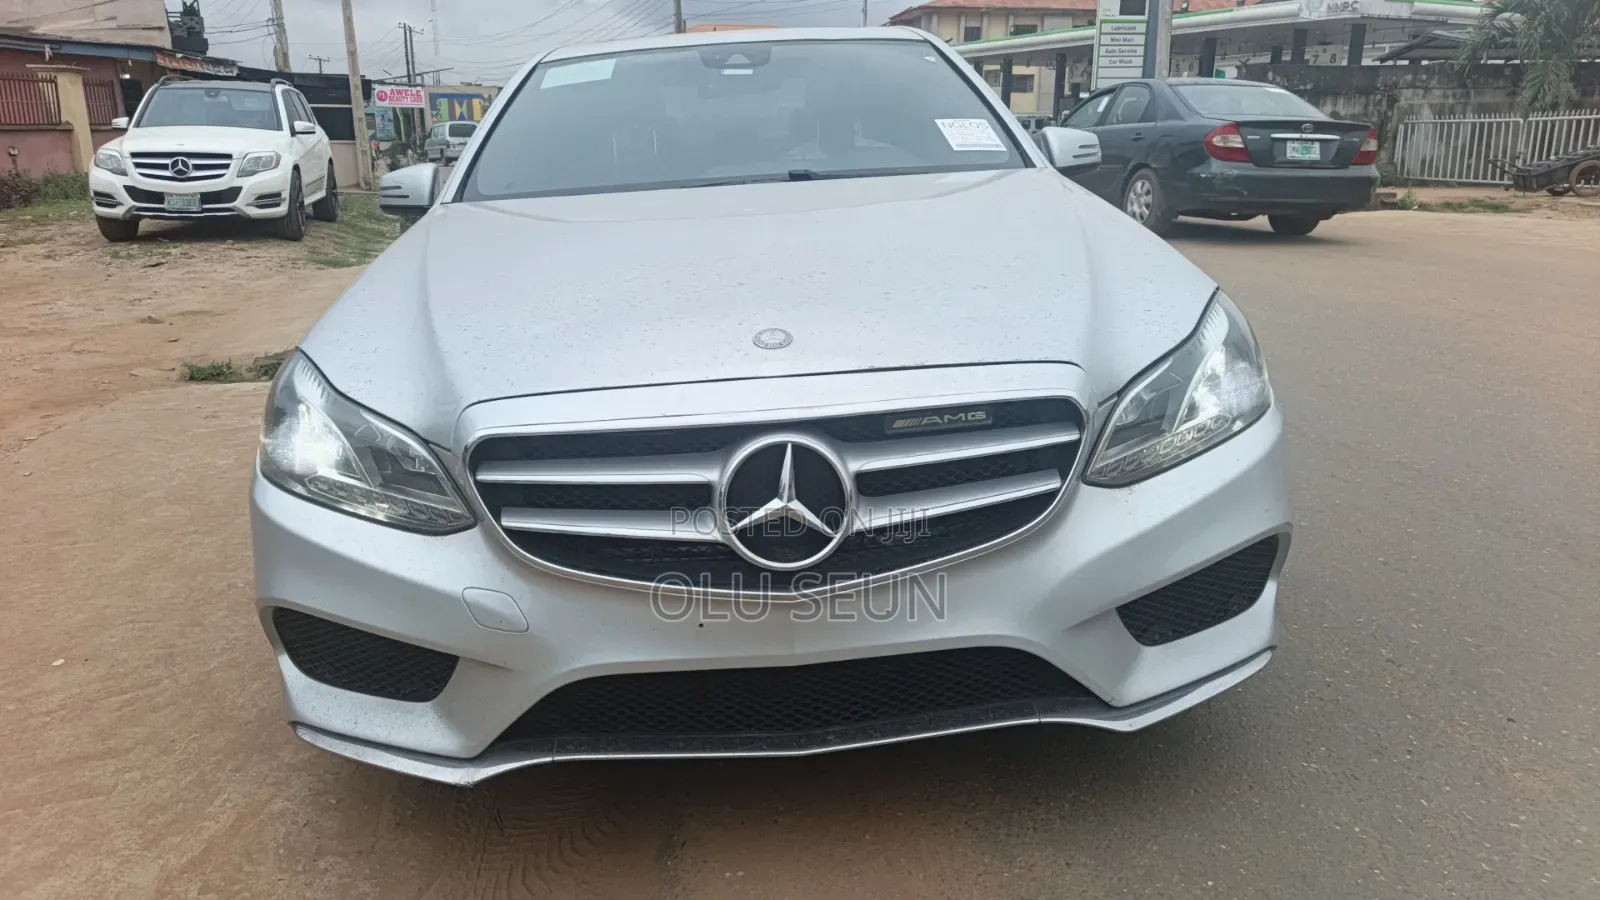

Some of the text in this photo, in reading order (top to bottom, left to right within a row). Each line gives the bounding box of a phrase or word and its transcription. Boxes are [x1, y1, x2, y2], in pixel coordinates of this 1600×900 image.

[1312, 53, 1336, 64] 7 8
[390, 88, 422, 97] AWELE
[920, 411, 986, 426] AMG
